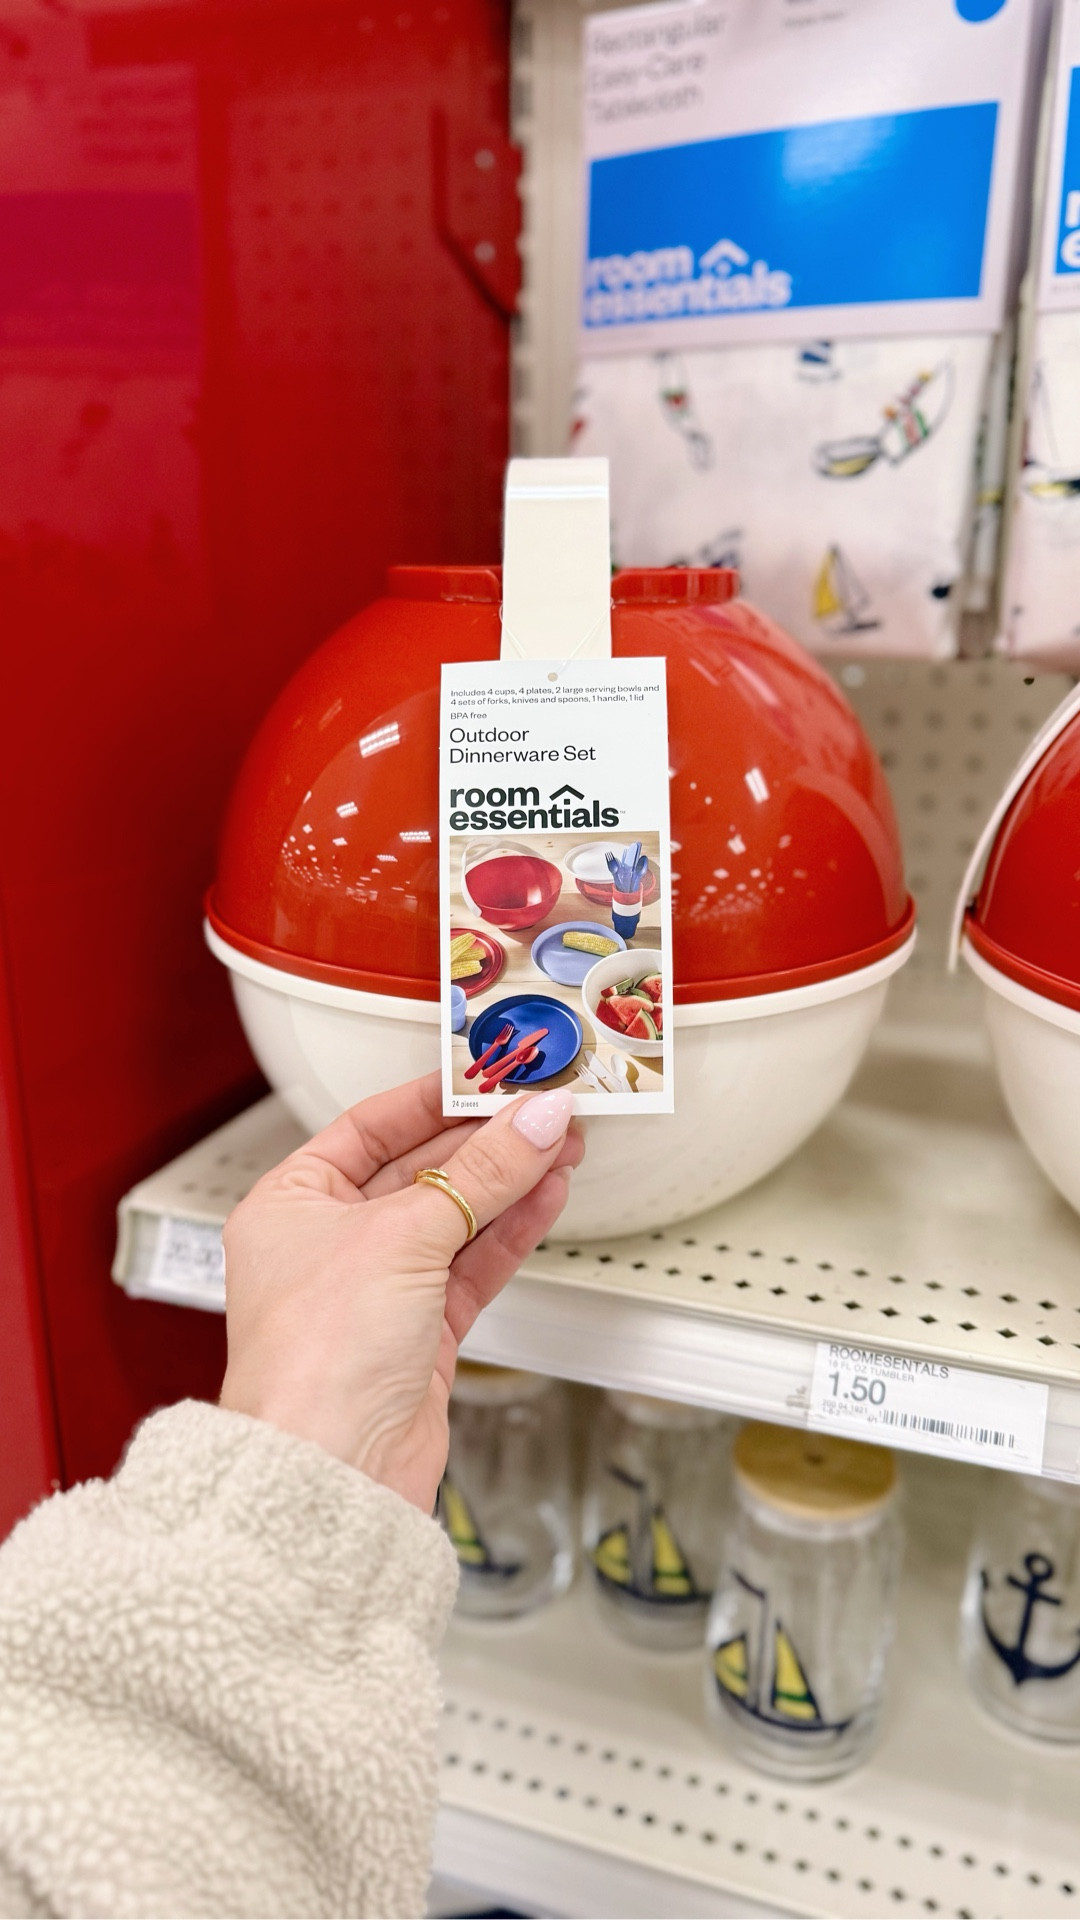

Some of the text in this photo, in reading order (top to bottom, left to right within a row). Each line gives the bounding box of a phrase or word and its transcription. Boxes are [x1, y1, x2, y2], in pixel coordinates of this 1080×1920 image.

[586, 245, 694, 290] room
[487, 697, 511, 705] forks,
[557, 696, 591, 705] spoons,
[597, 694, 628, 703] handle,
[518, 687, 525, 695] 4
[526, 687, 554, 696] plates,
[555, 686, 561, 694] 2
[562, 686, 584, 695] large
[585, 685, 616, 694] serving
[617, 685, 642, 693] bowls
[643, 684, 660, 692] and
[449, 727, 530, 744] Outdoor
[449, 745, 596, 764] Dinnerware Set
[450, 786, 540, 808] room
[452, 1100, 460, 1108] 24
[829, 1344, 950, 1379] ROOMESENTALS
[840, 1361, 851, 1371] FL
[854, 1363, 867, 1374] OZ
[870, 1366, 915, 1384] TUMBLER
[828, 1371, 887, 1406] 1.50
